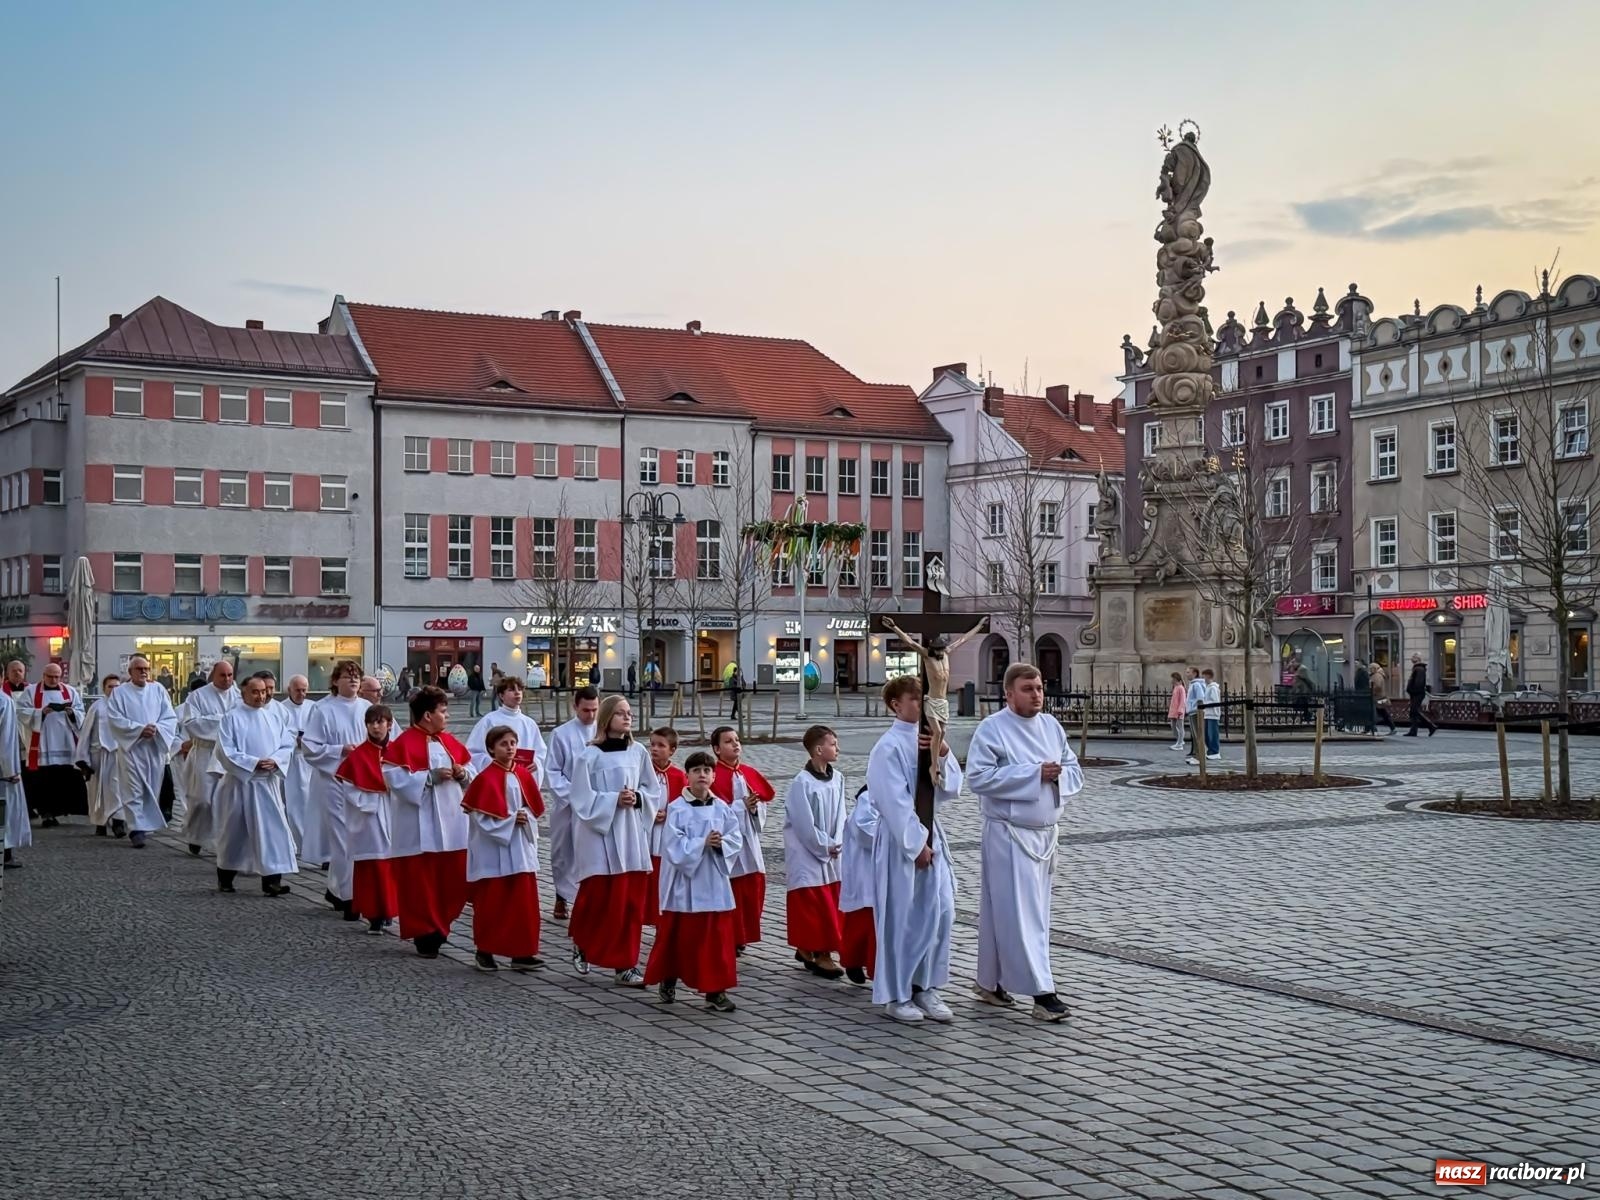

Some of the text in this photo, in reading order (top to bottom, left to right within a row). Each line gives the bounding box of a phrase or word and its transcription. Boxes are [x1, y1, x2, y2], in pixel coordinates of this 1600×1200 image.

[112, 594, 247, 621] BOLKO
[1379, 598, 1437, 609] RESTAURACJA
[1453, 594, 1488, 610] SHIR
[827, 618, 871, 629] JUBILE
